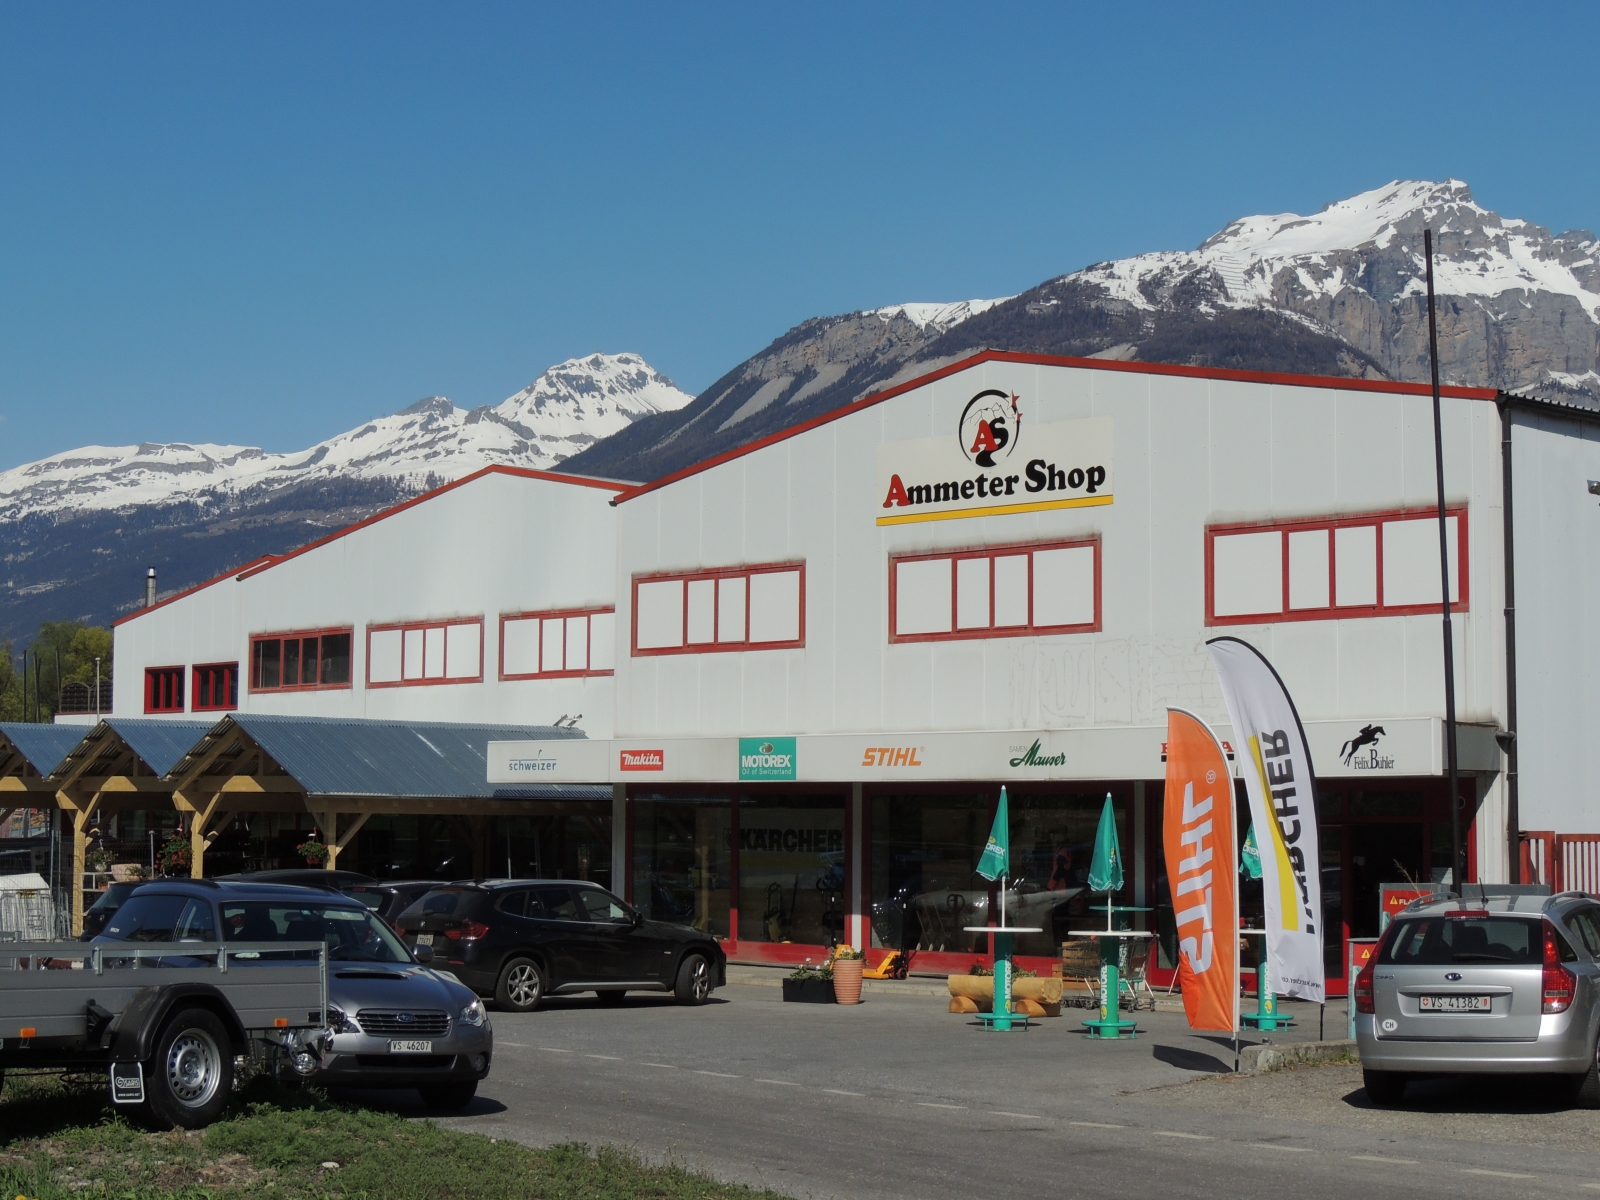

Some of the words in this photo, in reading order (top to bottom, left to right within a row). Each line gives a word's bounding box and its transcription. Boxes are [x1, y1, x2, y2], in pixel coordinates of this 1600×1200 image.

[970, 416, 1009, 468] AS
[883, 474, 1019, 508] Ammeter
[1025, 459, 1106, 493] Shop
[861, 747, 922, 767] STIHL
[1008, 745, 1028, 753] SAMEN
[1009, 737, 1067, 768] Mauser
[1353, 756, 1369, 770] Felix
[1369, 748, 1395, 770] Bühler
[508, 759, 557, 771] schweizer
[741, 754, 792, 768] MOTOREX
[759, 767, 792, 775] Switzerland
[739, 828, 843, 853] KÄRCHER
[985, 842, 1006, 856] OREX
[1004, 954, 1012, 1000] MOTOREX
[1100, 957, 1108, 1005] MOTOREX
[1384, 1021, 1395, 1030] CH
